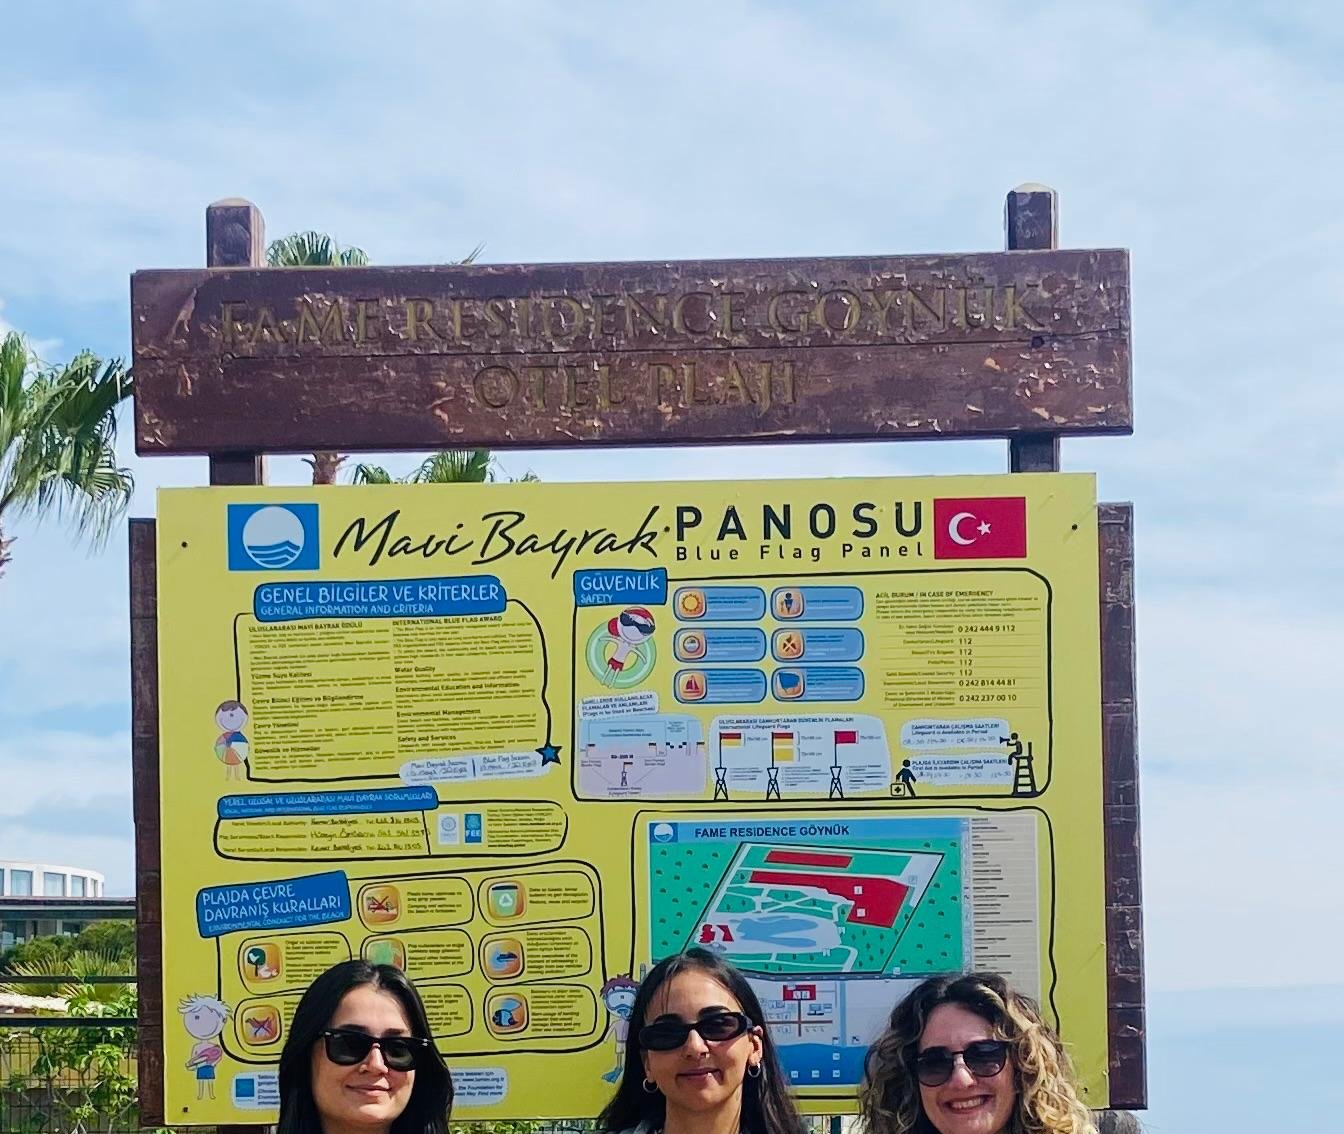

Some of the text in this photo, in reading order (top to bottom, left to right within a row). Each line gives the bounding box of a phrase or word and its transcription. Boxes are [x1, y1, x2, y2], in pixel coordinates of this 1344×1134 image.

[221, 276, 1046, 343] FAME RESIDENCE GÖYNÜK
[473, 359, 798, 418] OTEL PLAJI
[676, 501, 922, 541] PANOSU
[333, 505, 660, 580] Mavi Bayrak
[676, 542, 923, 562] Blue Flag Panel
[580, 572, 660, 591] GÜVENLİK
[260, 582, 499, 603] GENEL BİLGİLER VE KRİTERLER
[580, 593, 614, 604] SAFETY
[260, 603, 434, 616] GENERAL INFORMATION AND CRITERIA
[1002, 624, 1015, 632] 112
[465, 829, 482, 837] FEE
[694, 828, 727, 838] FAME
[799, 824, 850, 837] GÖYNÜK
[202, 884, 296, 906] PLAJDA ÇEVRE
[204, 896, 341, 922] DAVRANIŞ KURALLARI
